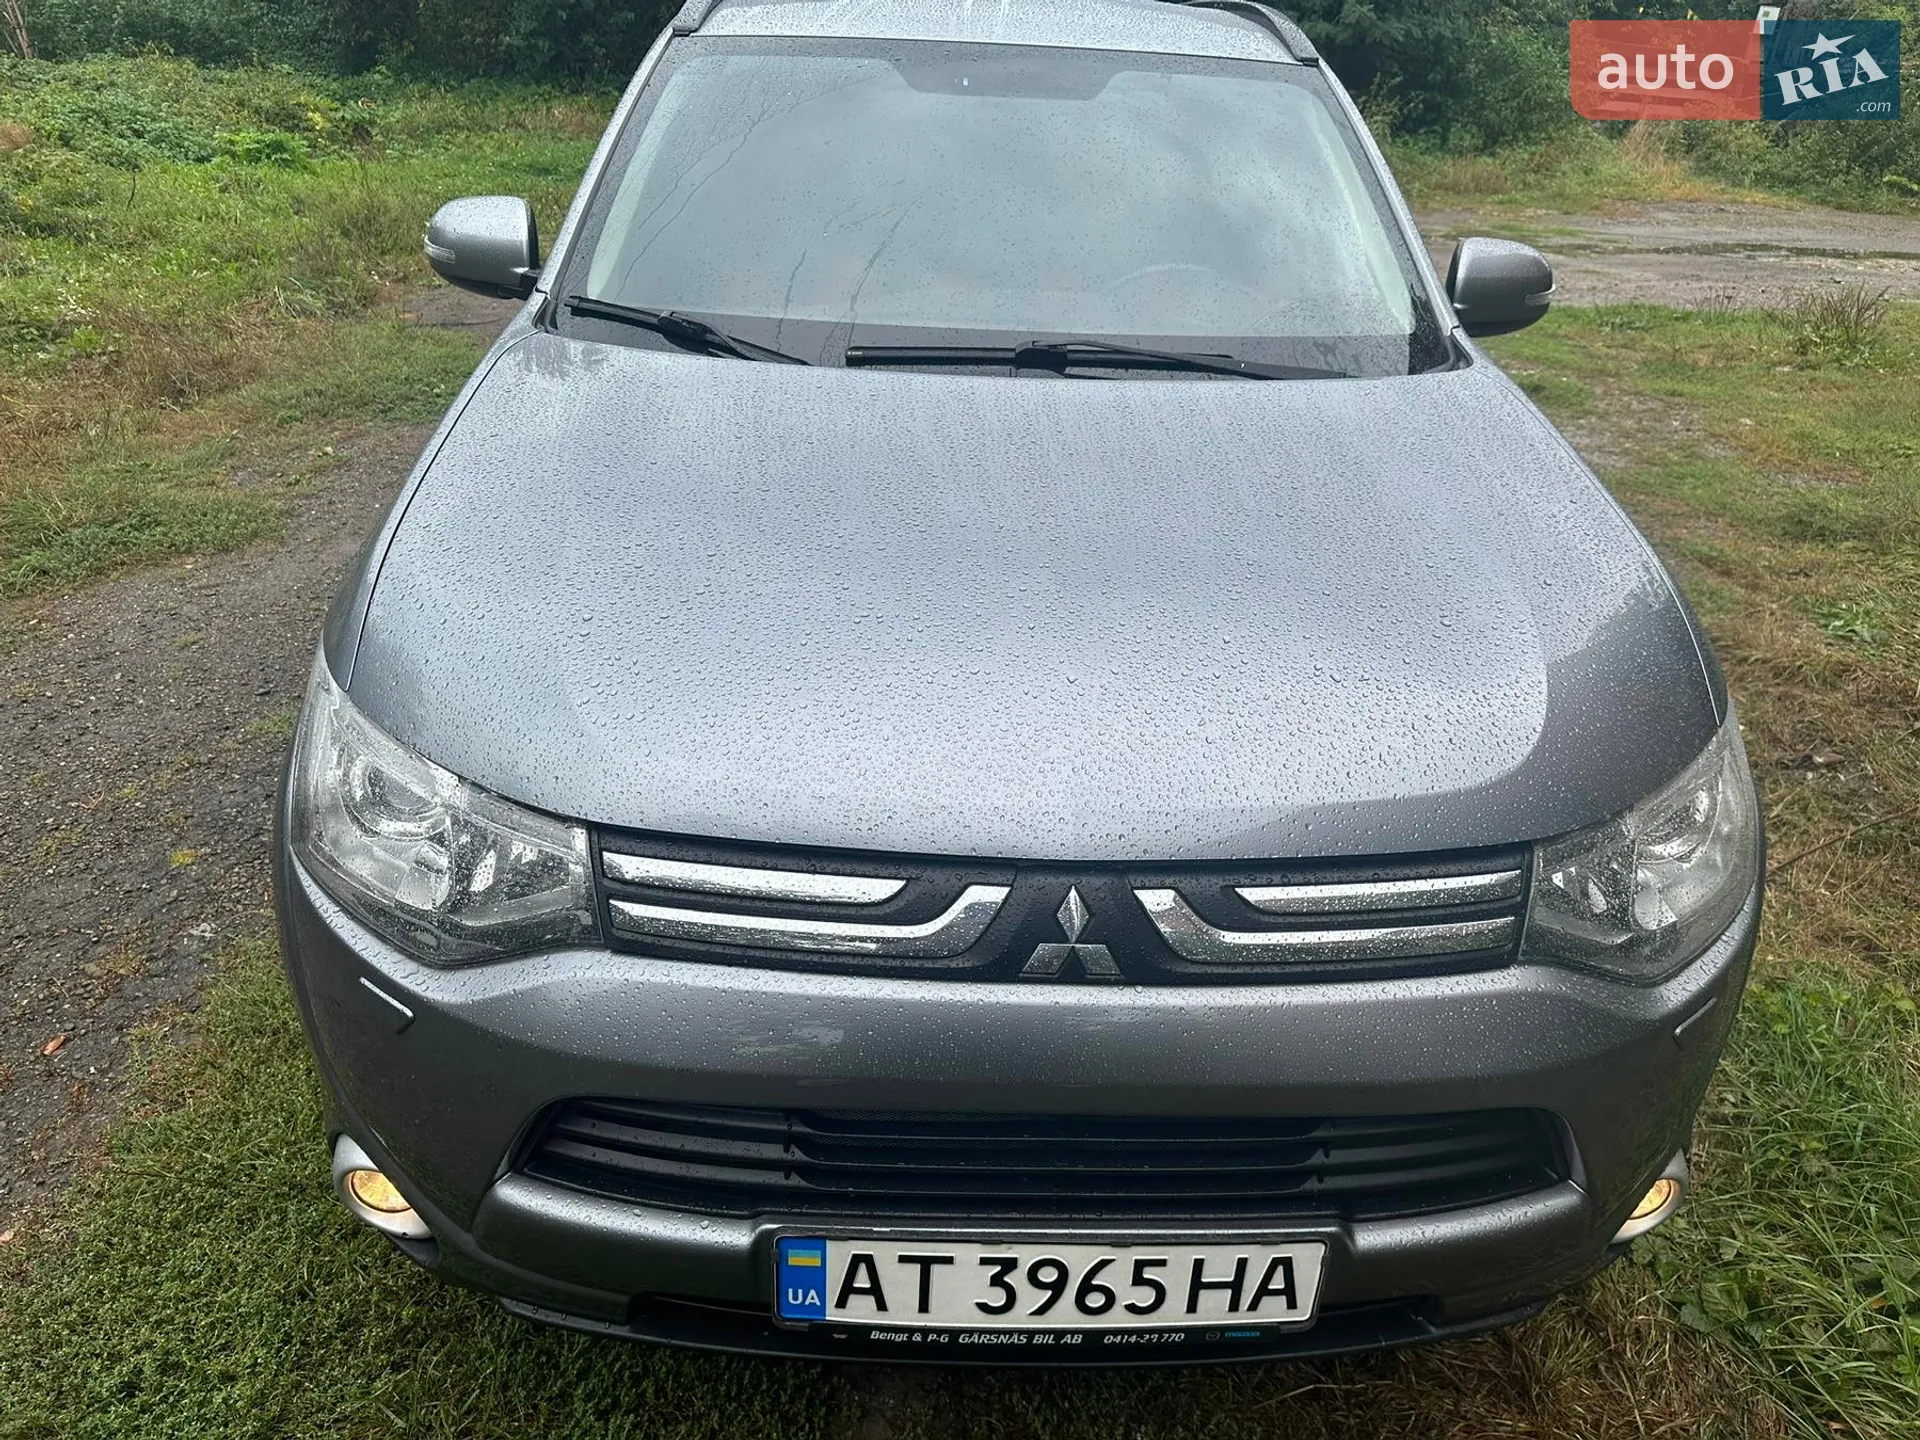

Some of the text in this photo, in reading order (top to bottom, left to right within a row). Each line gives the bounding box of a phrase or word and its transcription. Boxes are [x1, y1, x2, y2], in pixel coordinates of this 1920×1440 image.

[834, 1251, 1299, 1316] AT 3965 HA
[788, 1288, 821, 1305] UA
[870, 1330, 909, 1342] Bengt
[912, 1332, 922, 1341] &
[927, 1333, 949, 1342] P-G
[959, 1332, 1028, 1344] GÄRSNÄS
[1032, 1334, 1055, 1344] BIL
[1060, 1334, 1083, 1344] AB
